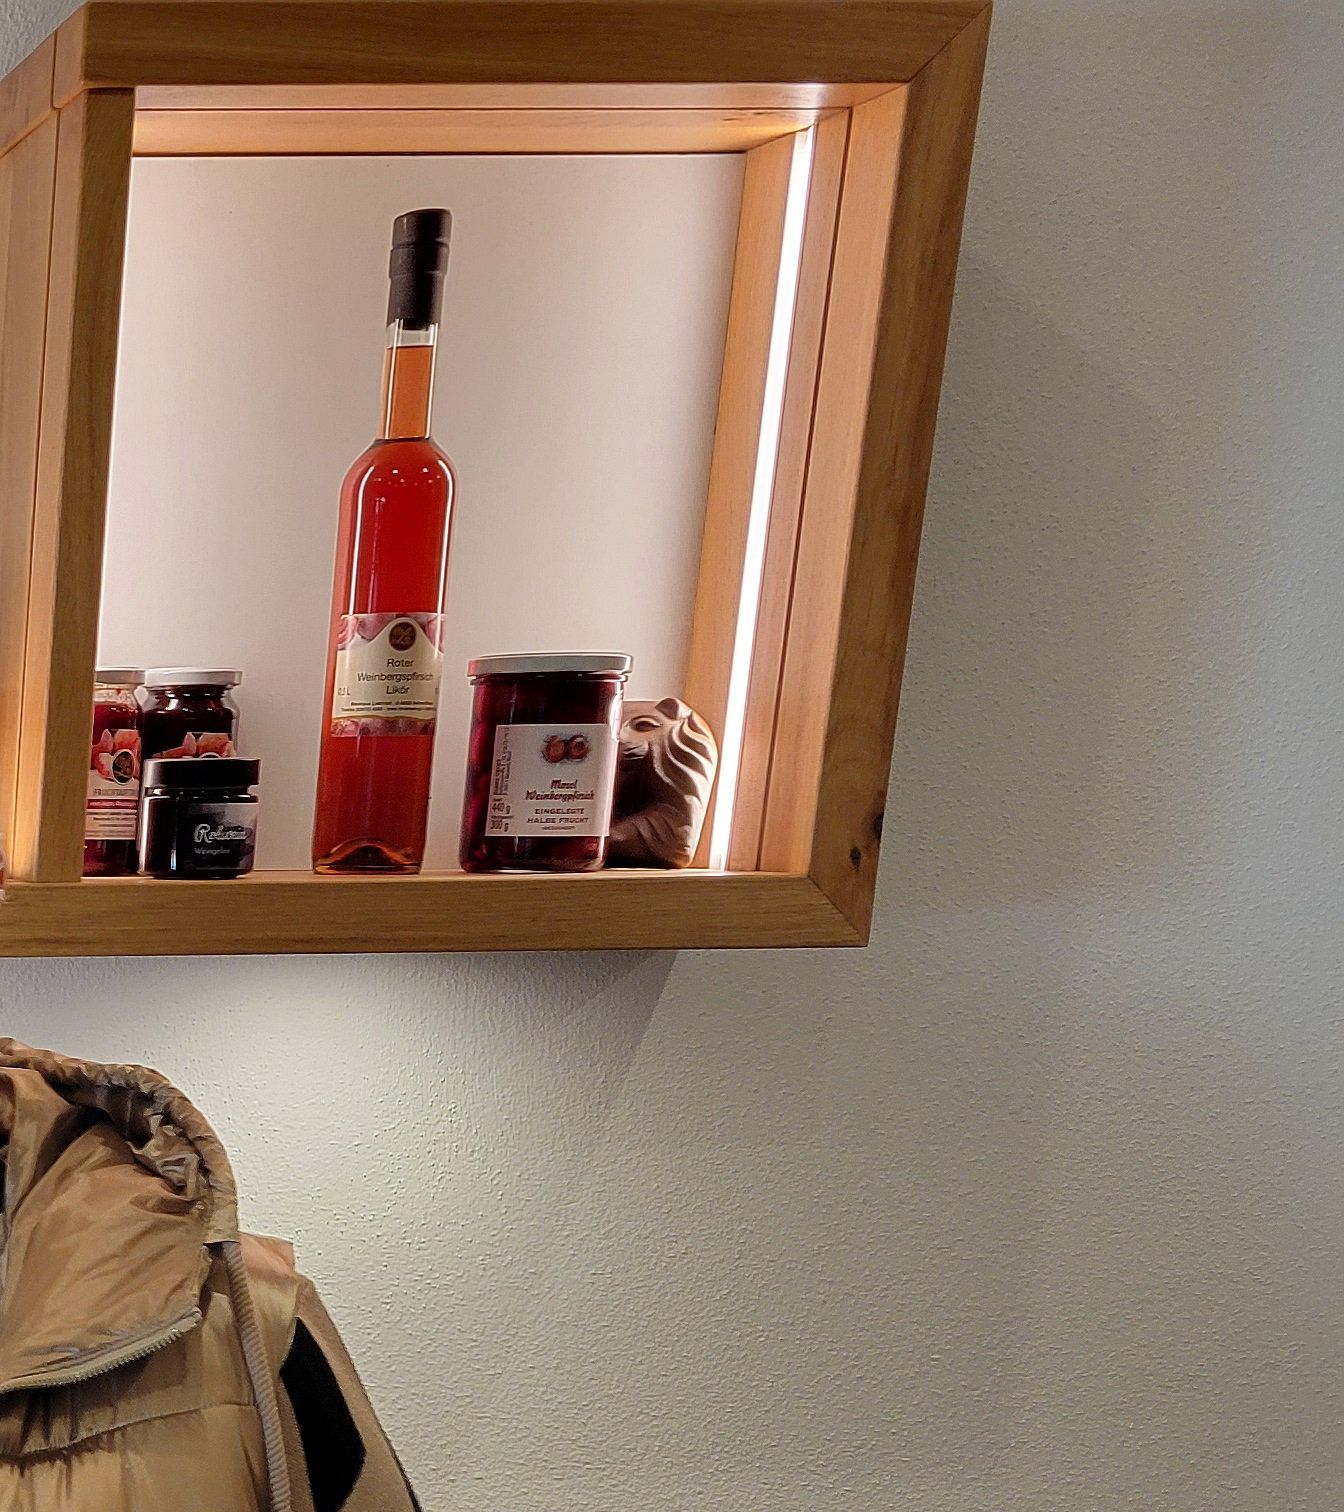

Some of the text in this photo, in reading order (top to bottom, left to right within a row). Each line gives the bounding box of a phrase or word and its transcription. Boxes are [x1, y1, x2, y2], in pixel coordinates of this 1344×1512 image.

[386, 658, 414, 667] Roter
[357, 671, 434, 683] Weinbergspfirsich
[385, 685, 410, 695] Likör
